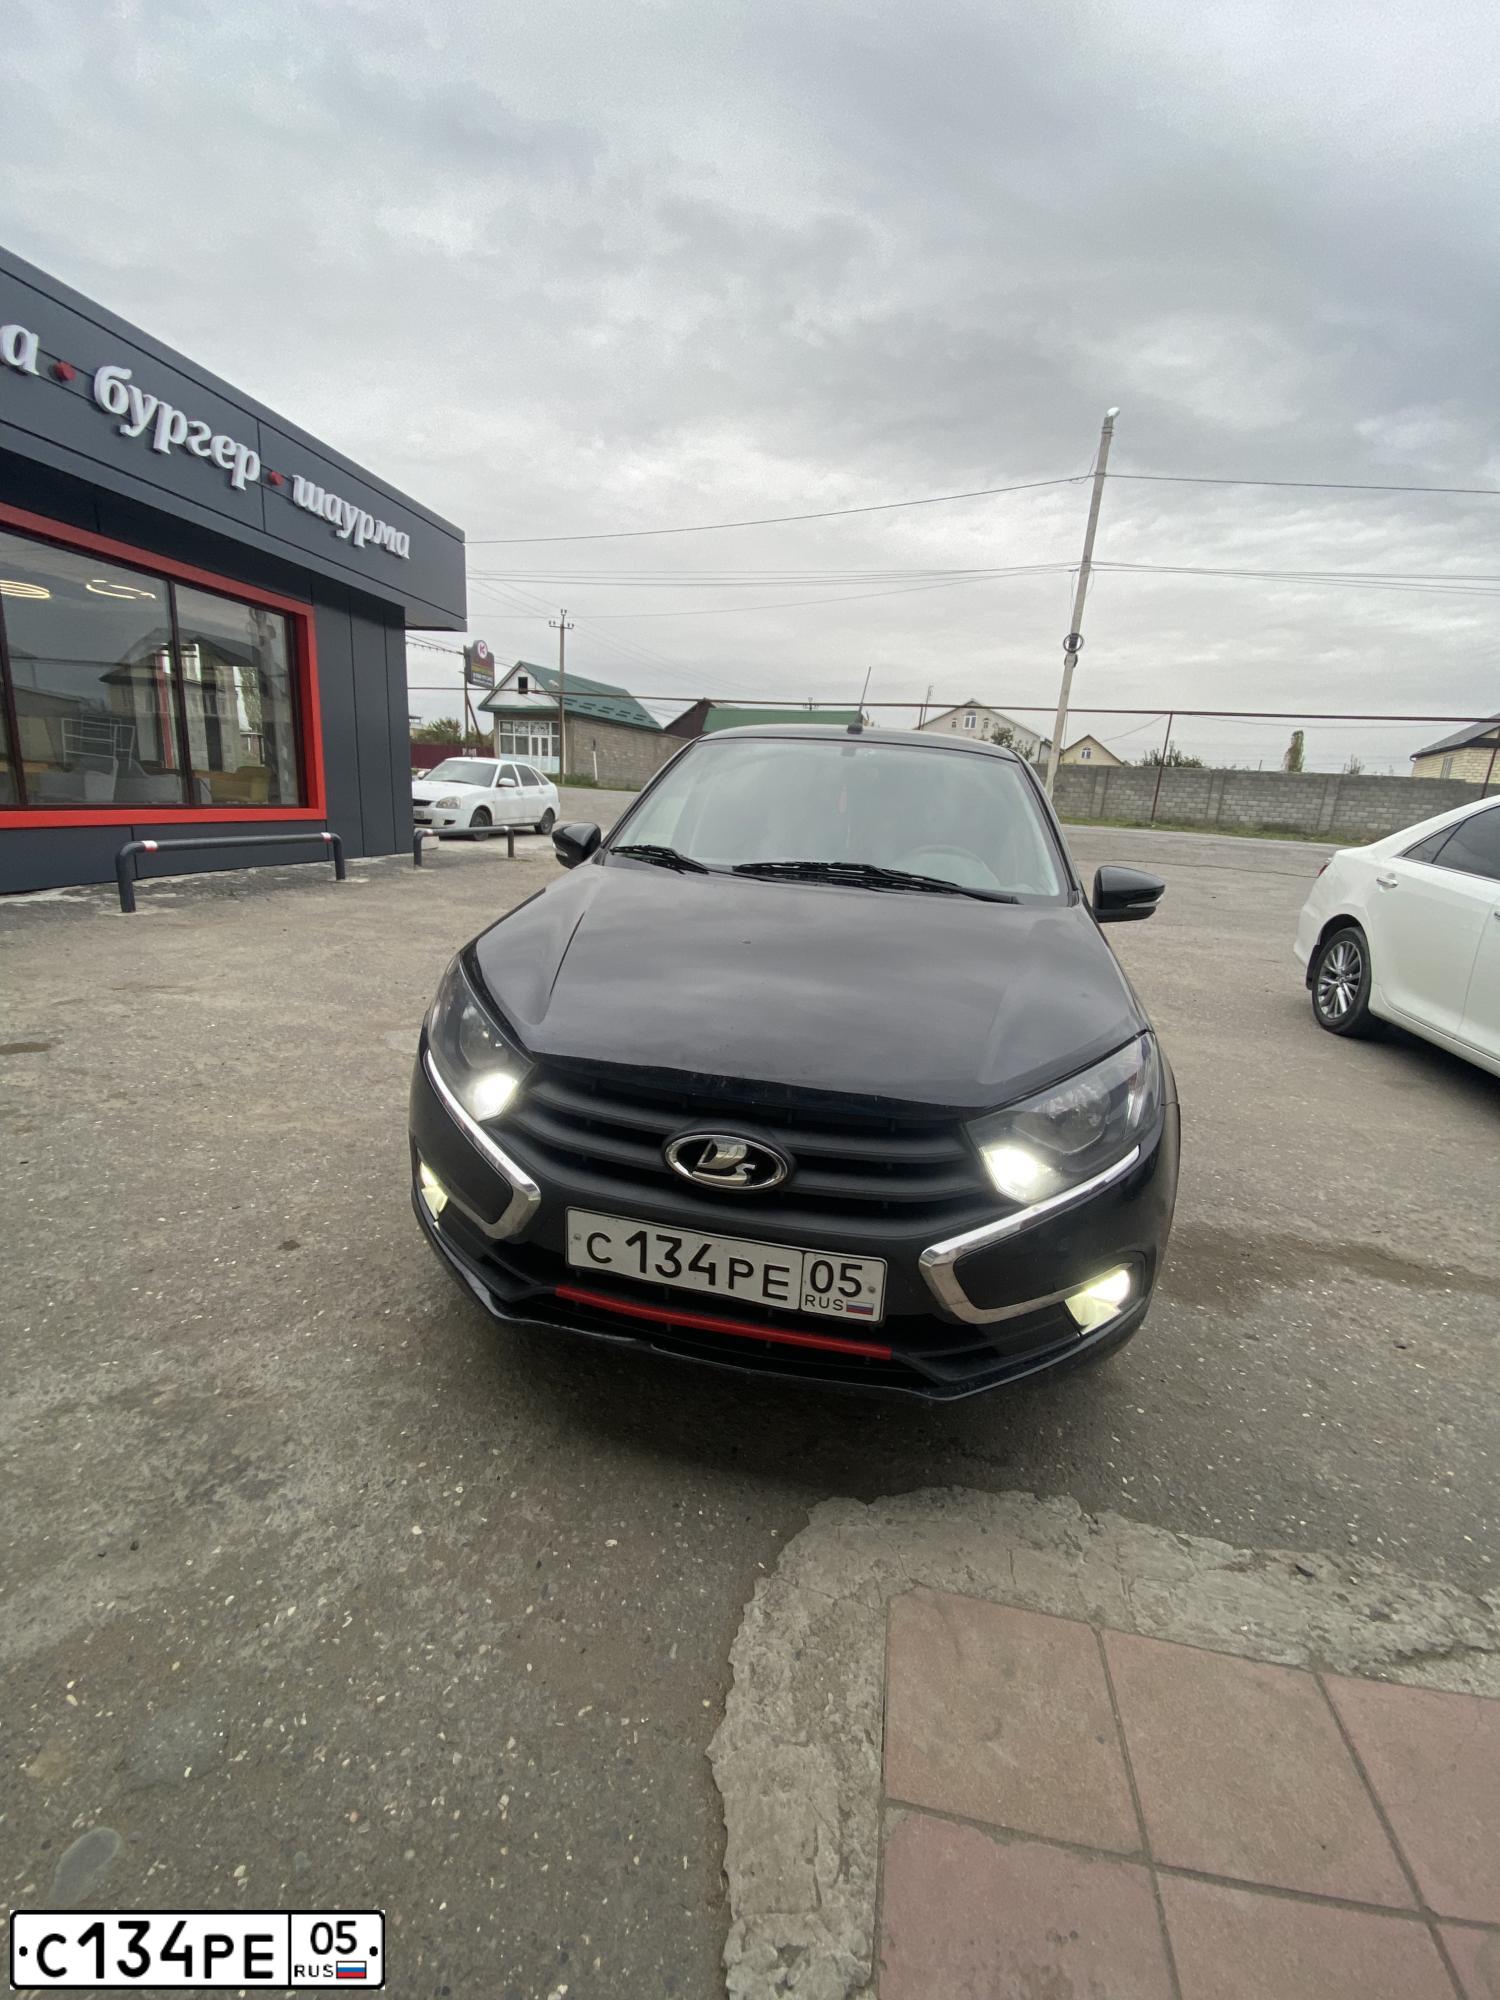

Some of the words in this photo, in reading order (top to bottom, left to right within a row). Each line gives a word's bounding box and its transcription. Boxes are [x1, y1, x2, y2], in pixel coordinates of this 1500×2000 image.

[94, 365, 260, 490] бургер
[292, 474, 410, 559] шаурма
[810, 1260, 863, 1298] 05
[804, 1294, 844, 1311] RUS
